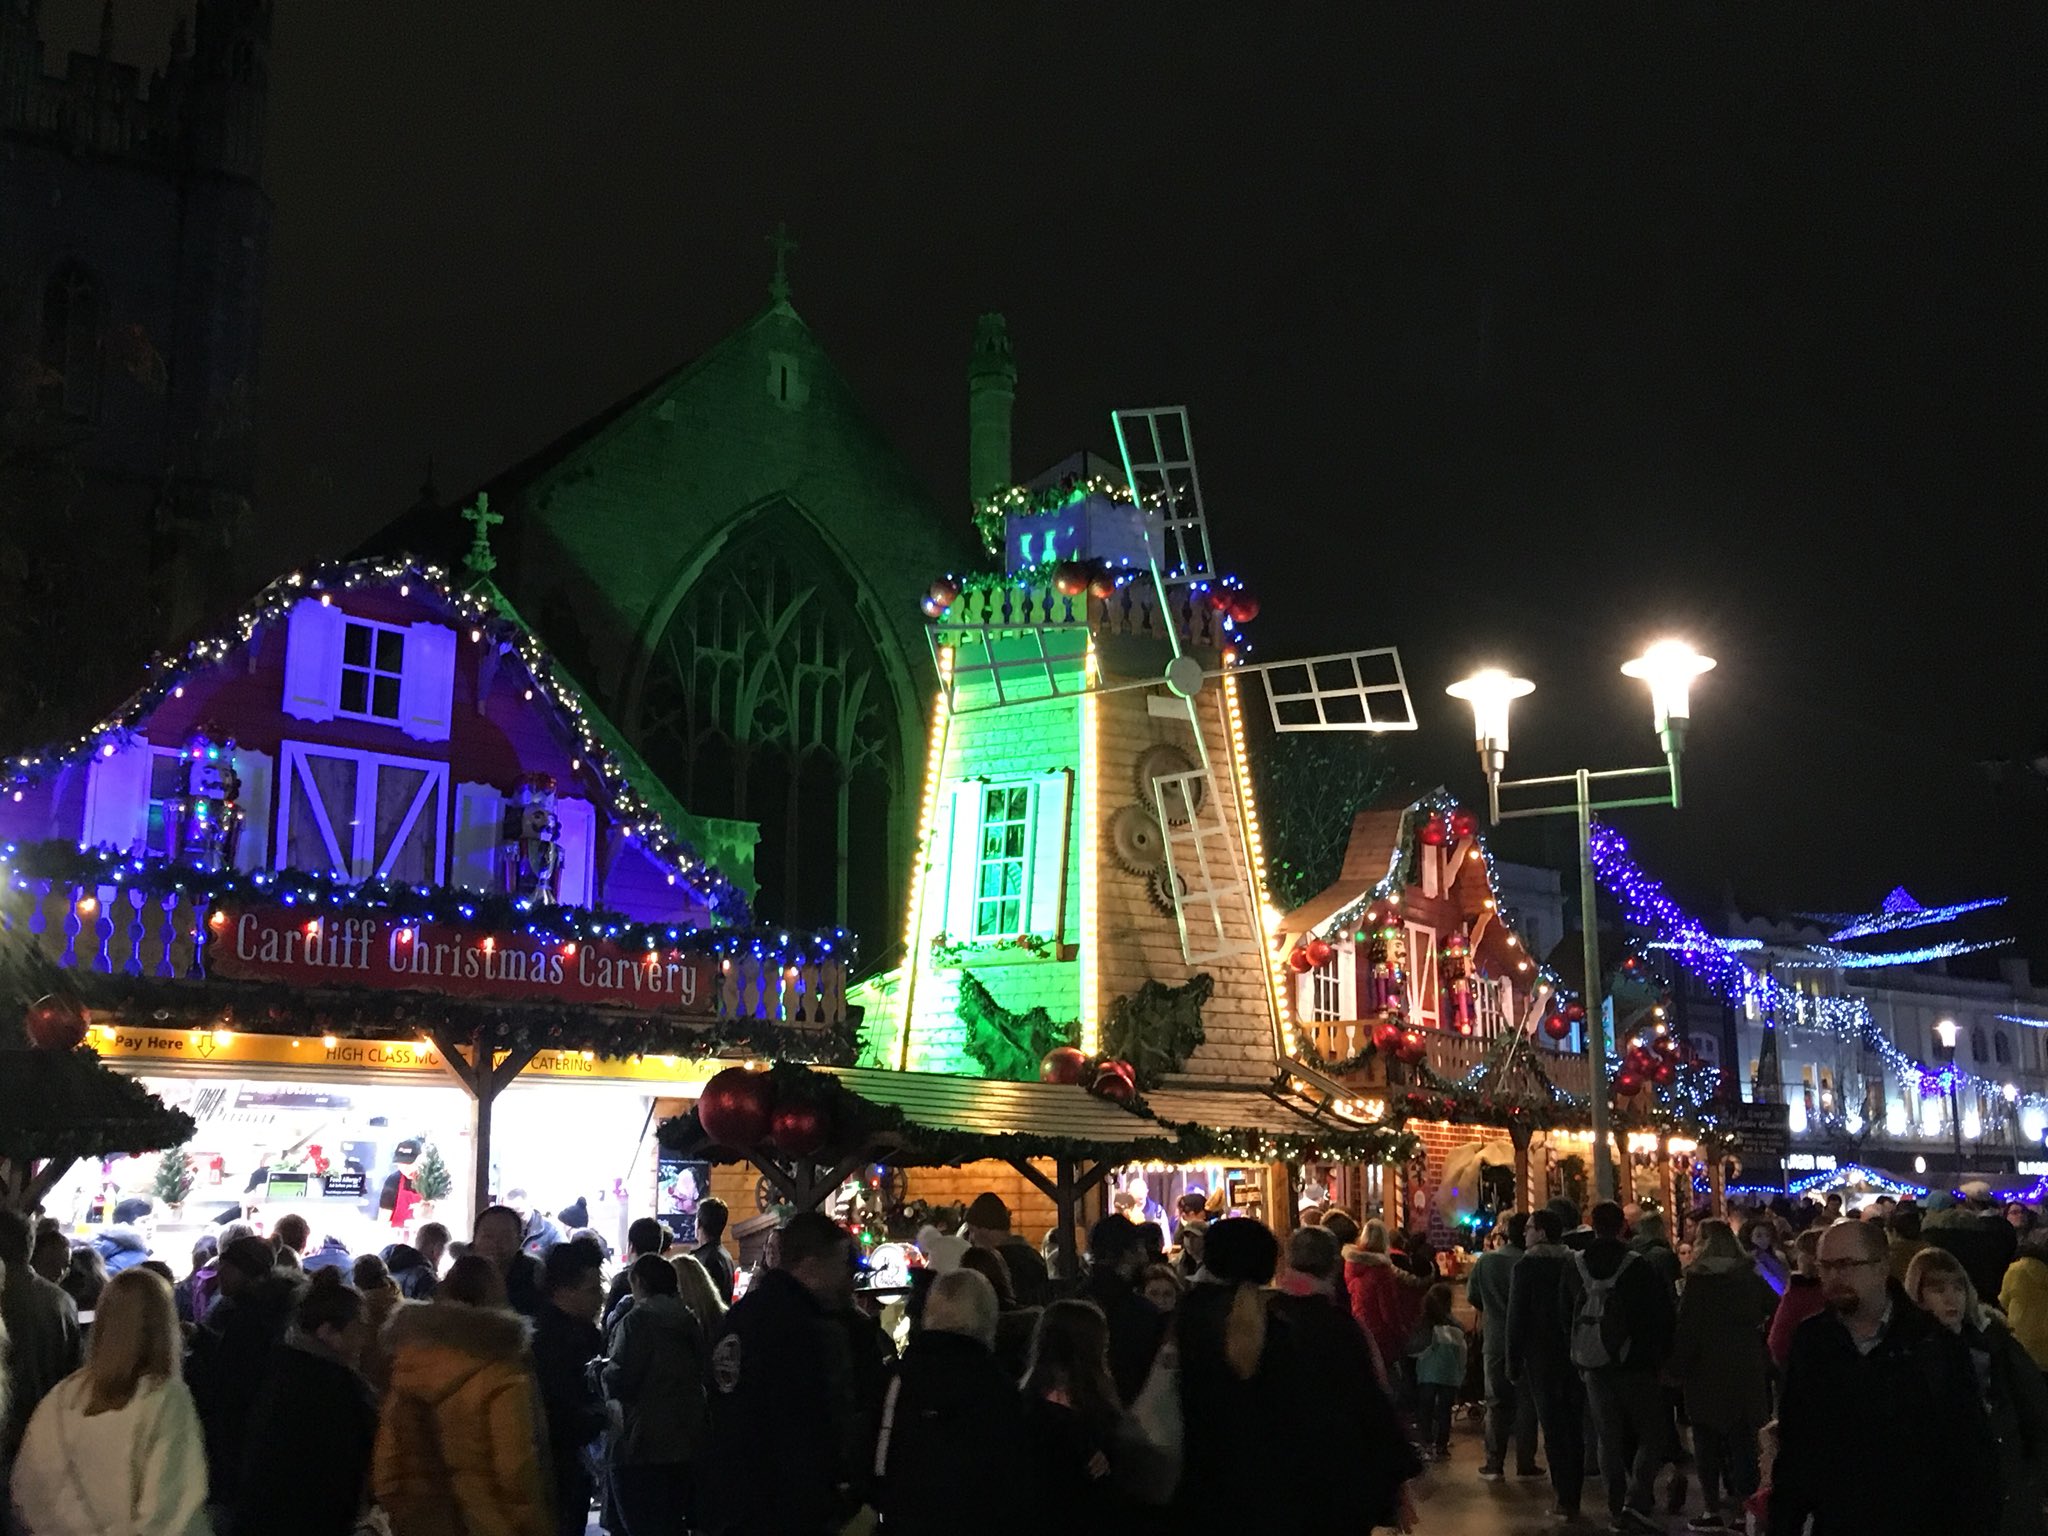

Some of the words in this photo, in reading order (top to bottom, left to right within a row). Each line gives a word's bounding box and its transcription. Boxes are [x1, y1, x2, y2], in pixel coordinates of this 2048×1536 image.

[236, 912, 376, 969] Cardiff
[388, 924, 565, 984] Christmas
[578, 944, 697, 1005] Carvery
[115, 1035, 143, 1050] Pay
[147, 1037, 184, 1050] Here
[326, 1046, 363, 1061] HIGH
[368, 1048, 410, 1063] CLASS
[531, 1056, 593, 1072] CATERING
